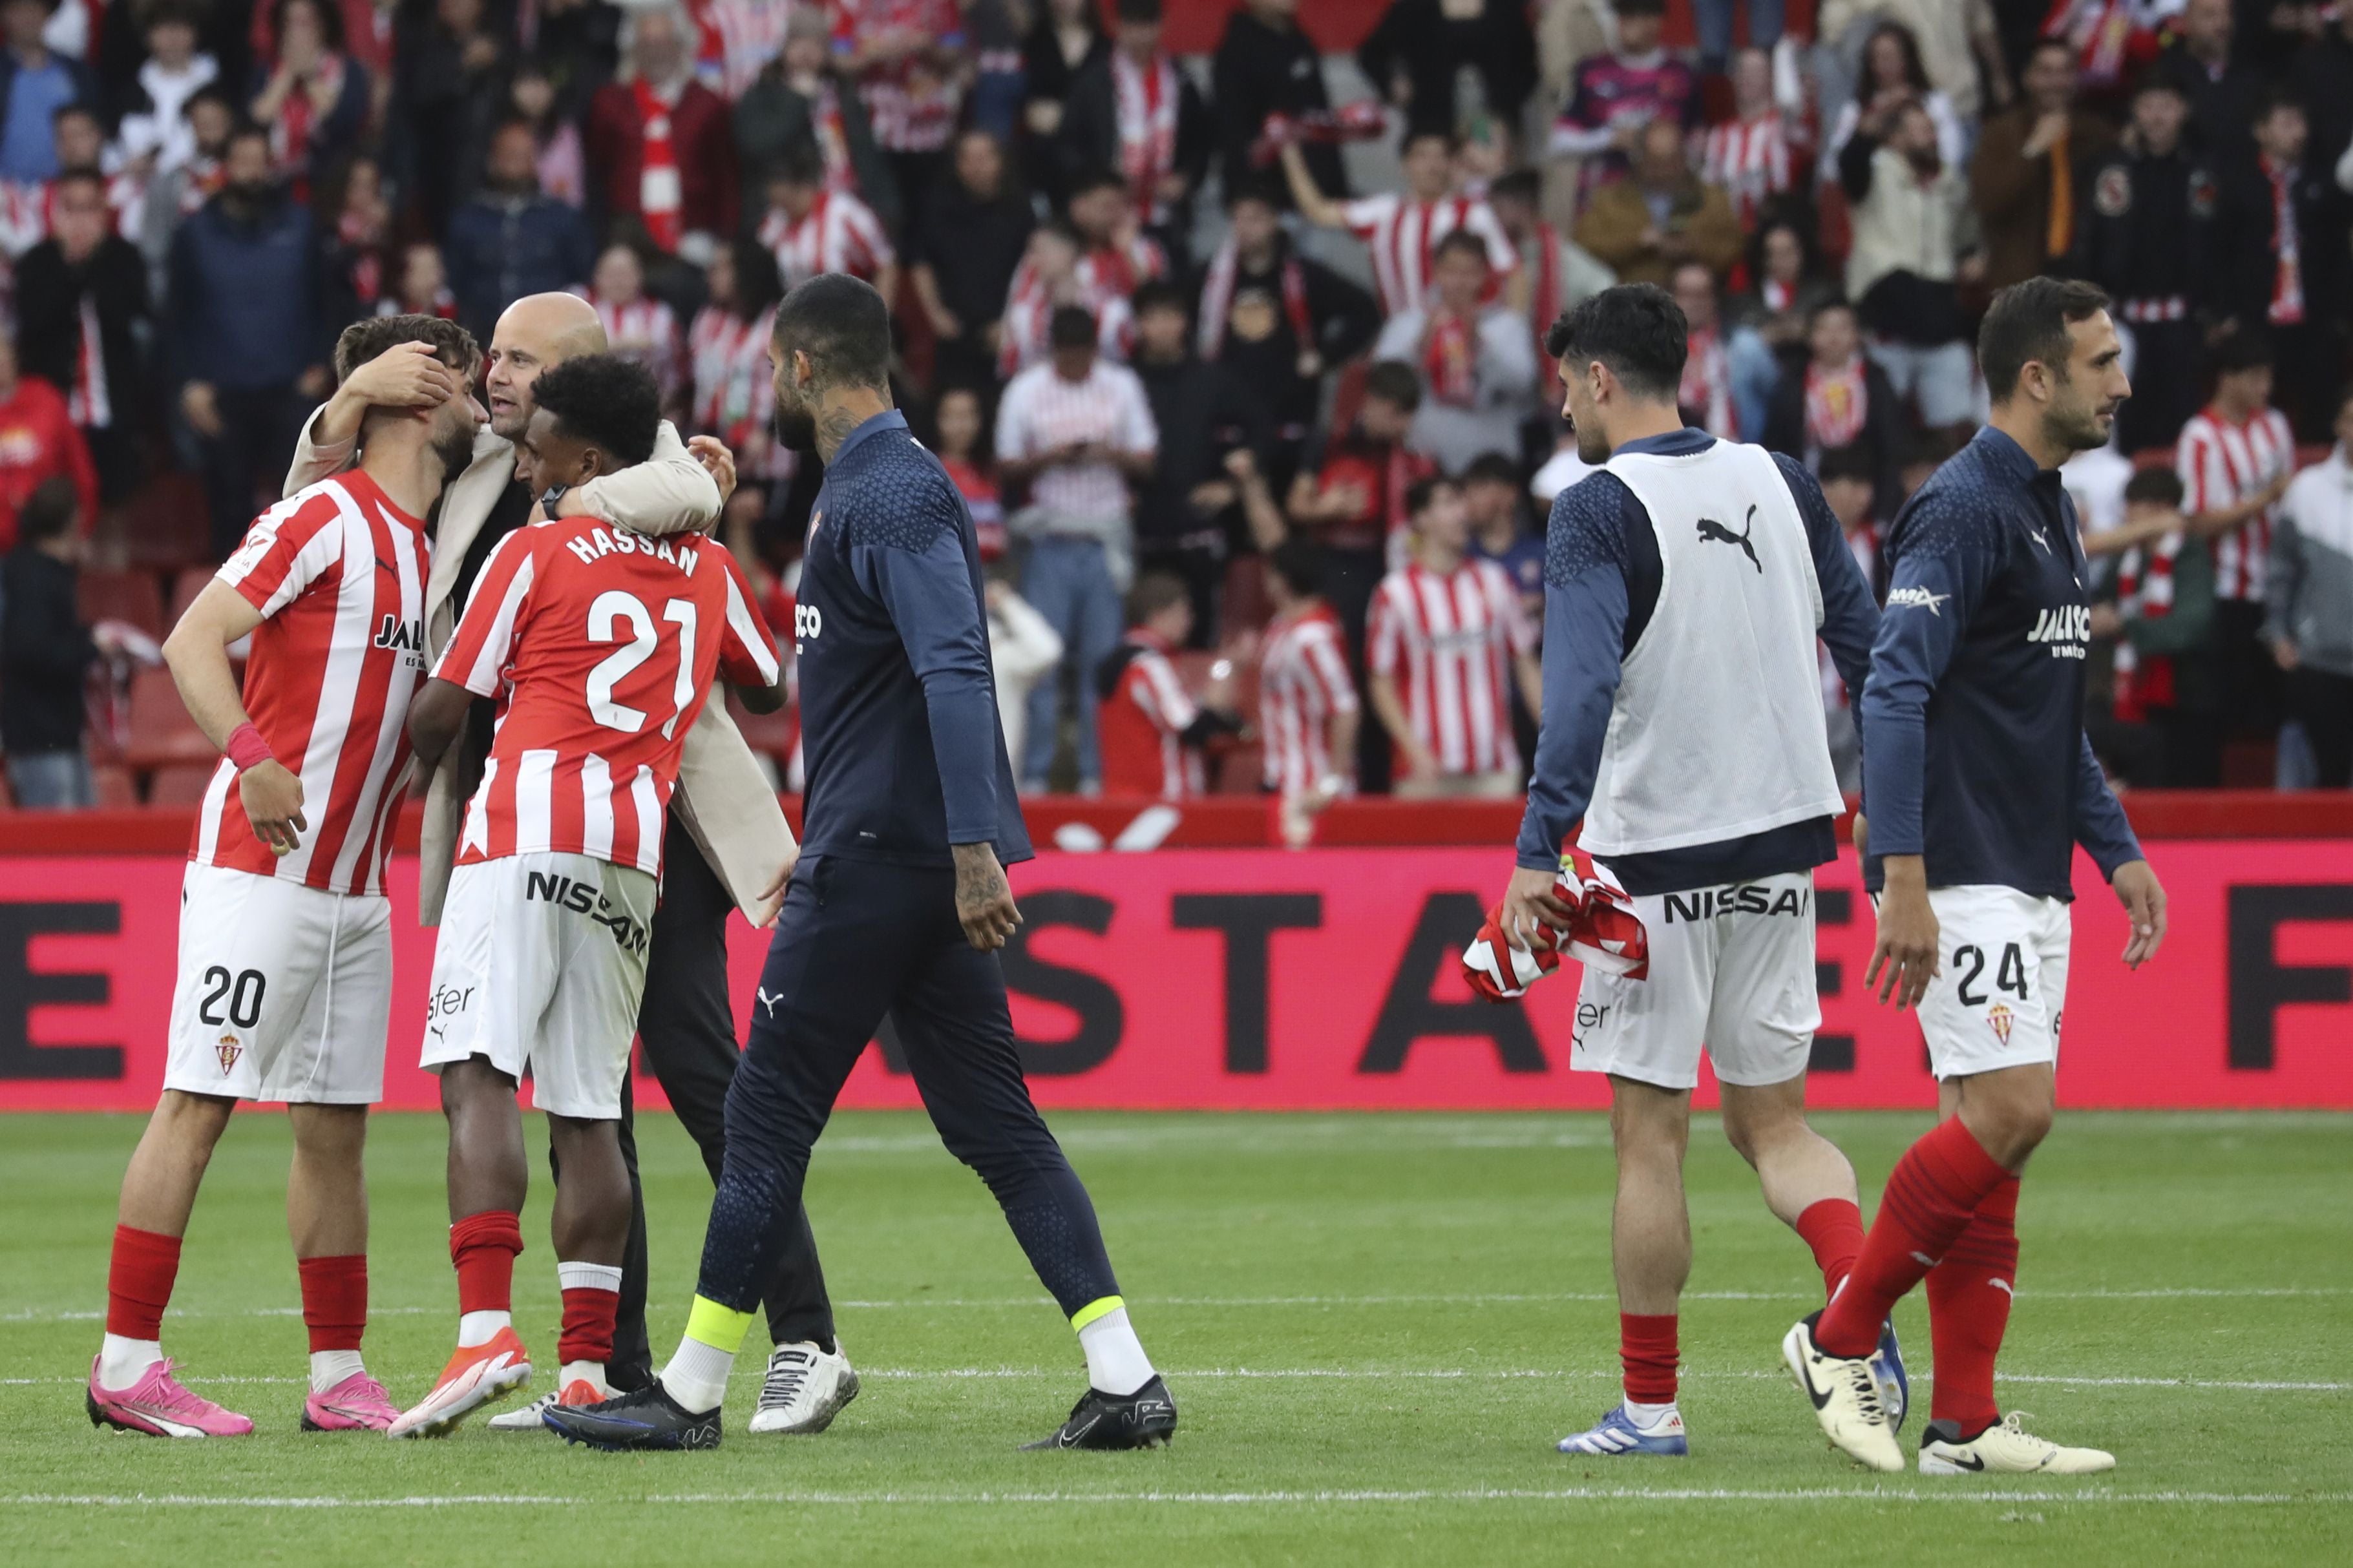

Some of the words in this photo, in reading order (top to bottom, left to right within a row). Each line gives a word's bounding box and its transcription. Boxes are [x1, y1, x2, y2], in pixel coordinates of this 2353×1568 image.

[565, 528, 699, 578] HASSAN
[586, 590, 697, 742] 21
[199, 965, 266, 1029] 20
[1952, 942, 2028, 1007] 24
[1577, 996, 1610, 1029] er
